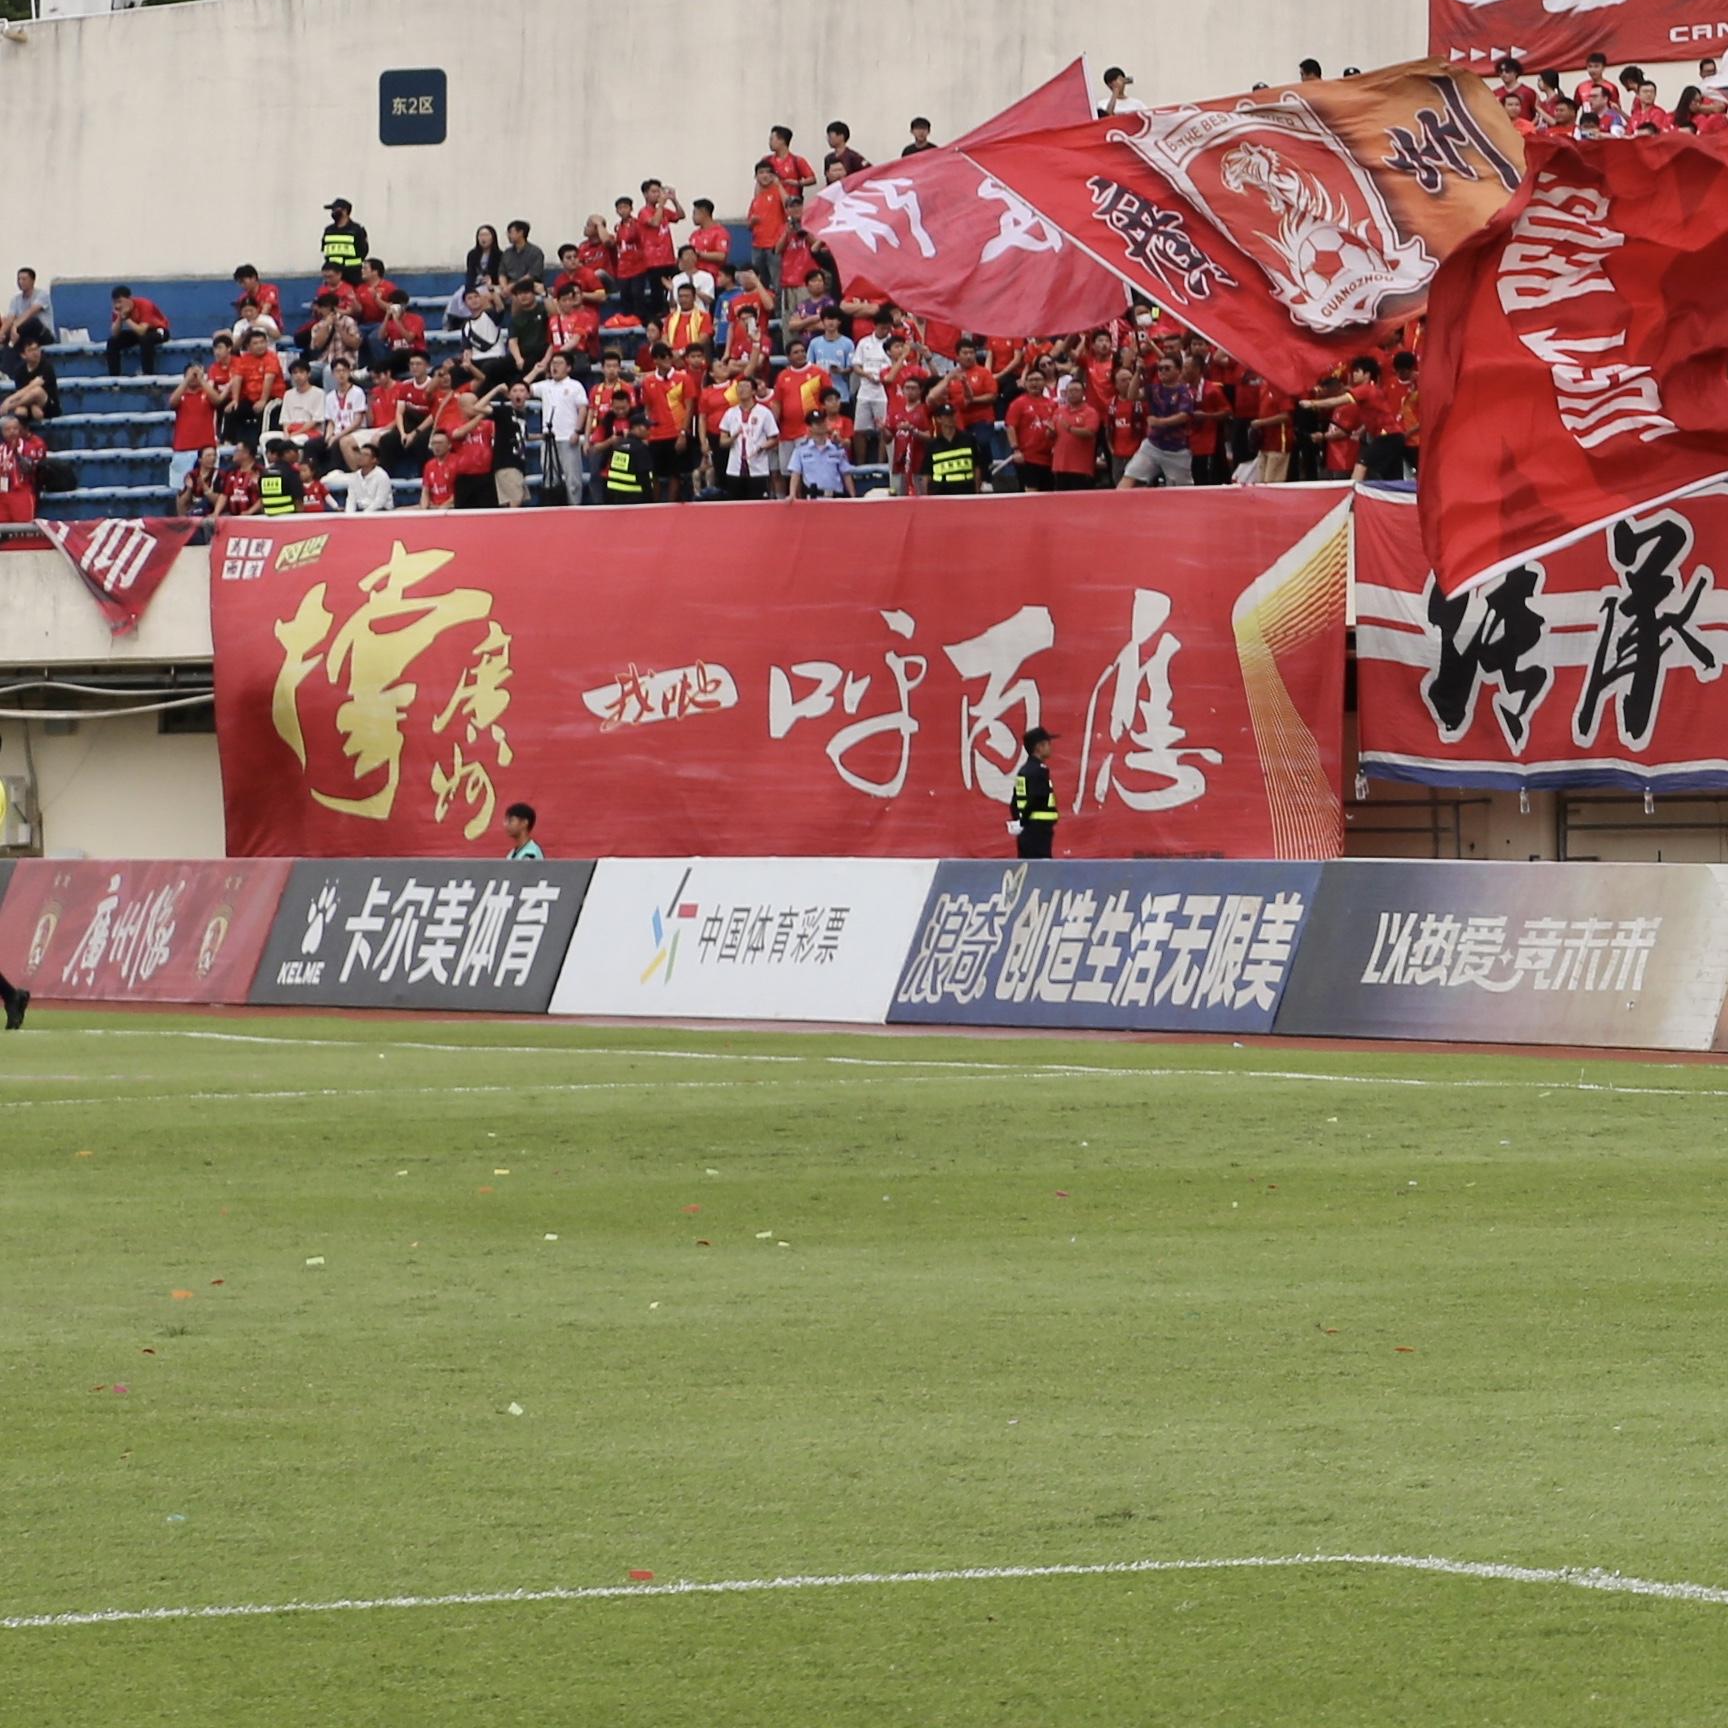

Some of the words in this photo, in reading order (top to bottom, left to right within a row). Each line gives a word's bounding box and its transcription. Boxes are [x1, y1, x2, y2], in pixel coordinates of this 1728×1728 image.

[391, 95, 434, 116] 东2区
[1319, 271, 1396, 320] GUANGZHOU
[1518, 328, 1680, 450] JUST
[338, 876, 561, 989] 卡尔美体育
[697, 904, 852, 967] 中国体育彩票
[994, 888, 1305, 1012] 创造生活无限美
[276, 962, 325, 985] KELME
